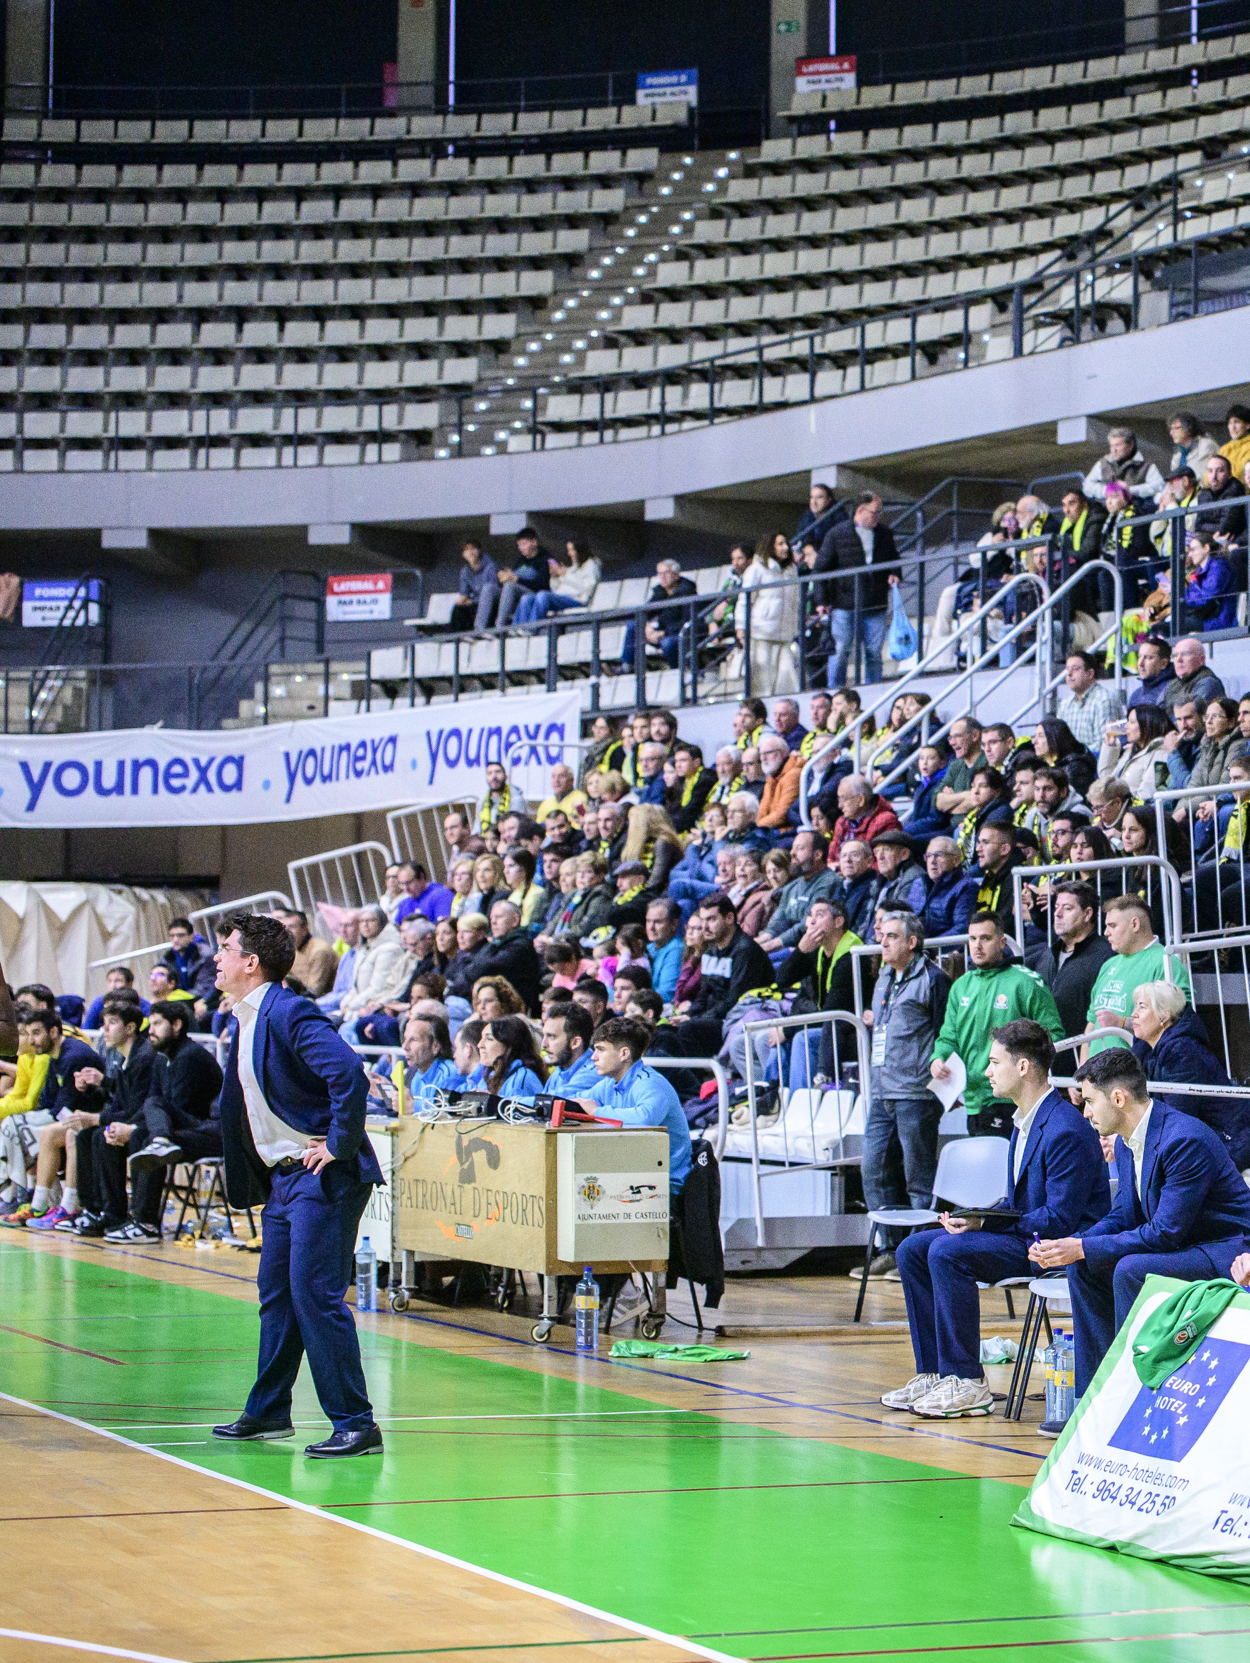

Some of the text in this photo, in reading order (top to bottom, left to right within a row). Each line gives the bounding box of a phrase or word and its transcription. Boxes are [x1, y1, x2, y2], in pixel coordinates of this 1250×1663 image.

[332, 579, 386, 593] LATERAL A
[282, 734, 398, 804] younexa
[425, 721, 567, 787] younexa
[19, 755, 246, 812] younexa
[399, 1178, 546, 1230] PATRONAT D'ESPORTS
[577, 1212, 620, 1221] AJUNTAMENT
[623, 1212, 632, 1220] DE
[1153, 1394, 1187, 1416] HOTEL
[1165, 1375, 1201, 1397] EURO
[1076, 1451, 1190, 1492] www.euro-hoteles.com
[1092, 1478, 1124, 1504] 964
[1118, 1486, 1143, 1510] 34
[1136, 1491, 1161, 1515] 25
